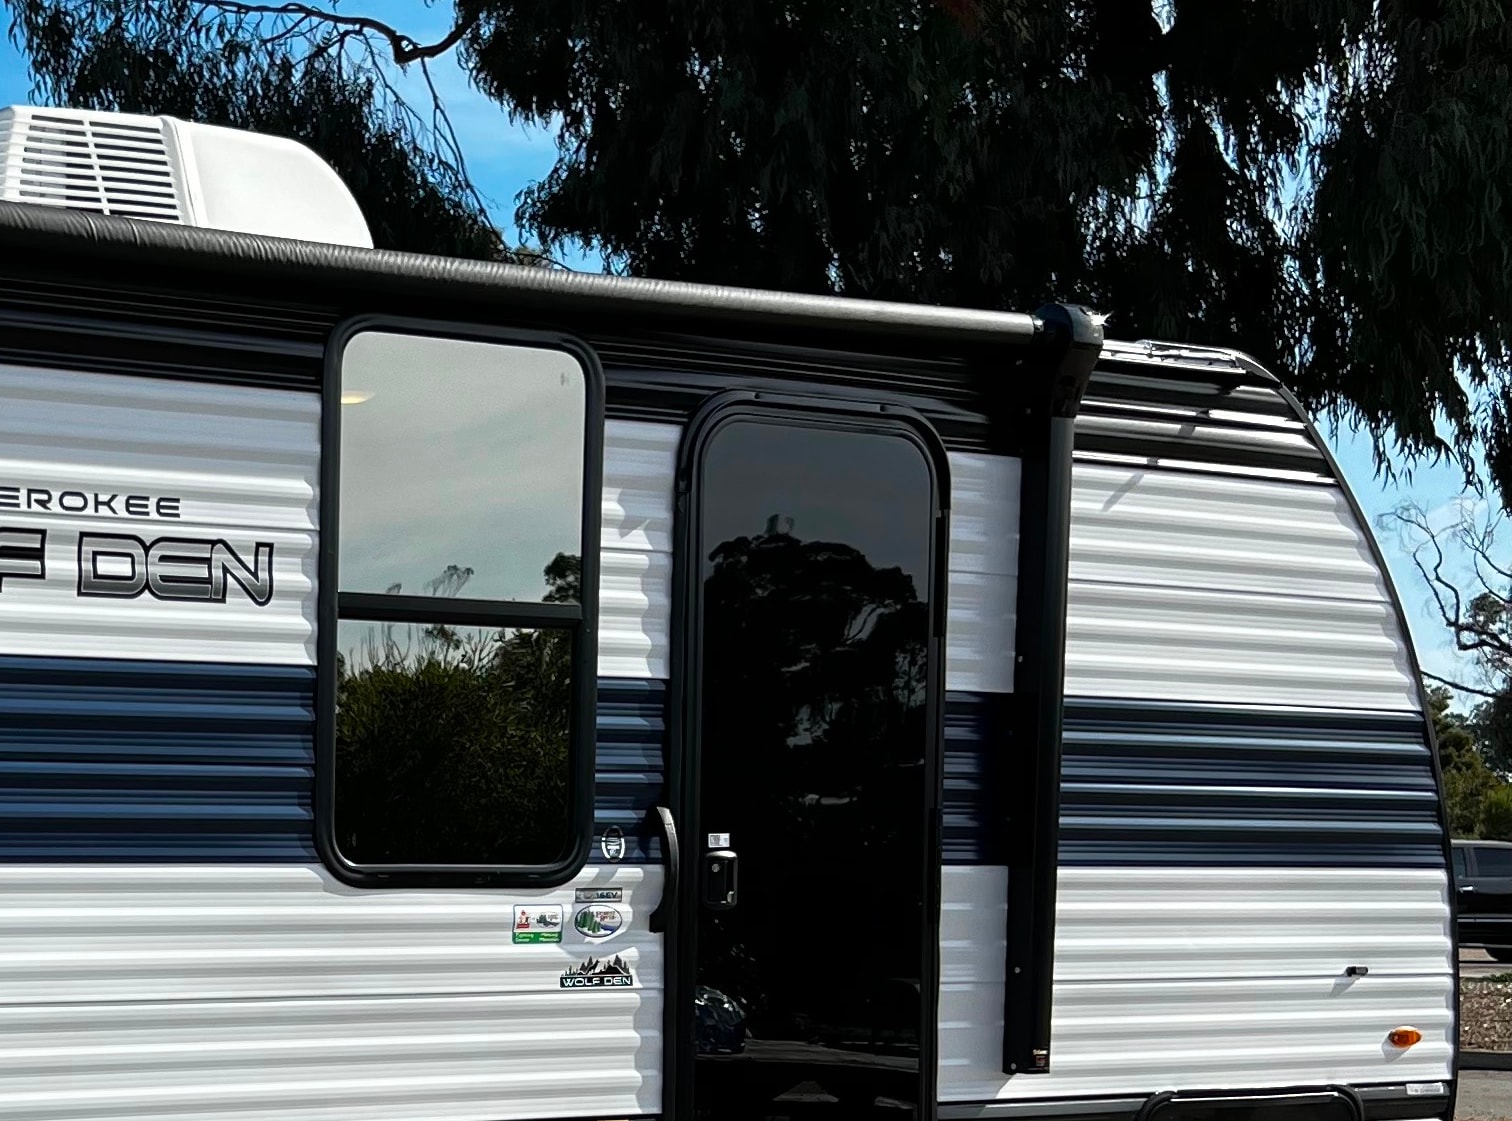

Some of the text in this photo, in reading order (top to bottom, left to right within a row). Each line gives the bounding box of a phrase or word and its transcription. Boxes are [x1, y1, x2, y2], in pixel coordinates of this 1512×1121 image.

[77, 531, 274, 606] DEN
[563, 976, 631, 987] WOLF DEN
